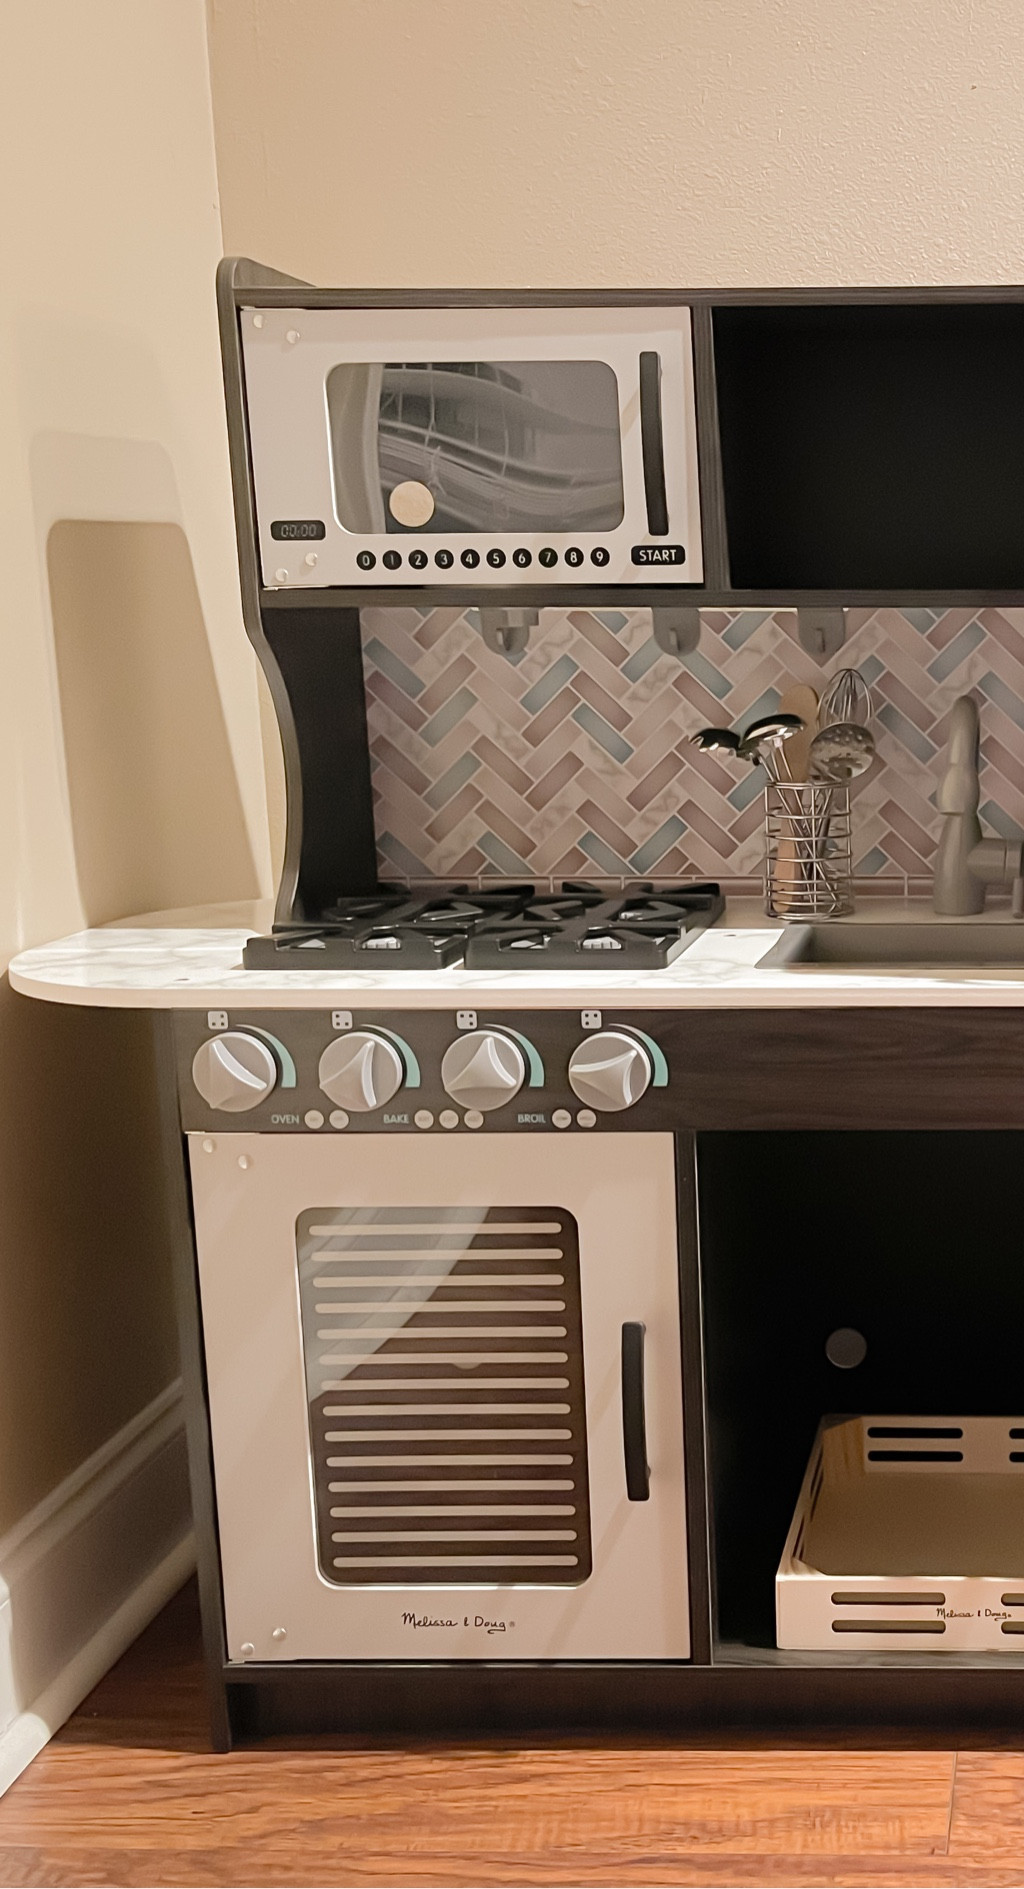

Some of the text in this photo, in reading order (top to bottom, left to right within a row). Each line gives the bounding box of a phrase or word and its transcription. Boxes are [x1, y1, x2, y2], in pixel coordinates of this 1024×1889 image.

[361, 554, 371, 567] 0
[414, 554, 422, 566] 2
[440, 553, 448, 565] 3
[465, 553, 473, 565] 4
[492, 552, 500, 564] 5
[518, 552, 526, 564] 6
[544, 551, 552, 563] 7
[570, 551, 578, 563] 8
[595, 551, 604, 563] 9
[639, 549, 677, 562] START
[271, 1114, 300, 1125] OVEN
[383, 1113, 409, 1125] BAKE
[517, 1113, 546, 1124] BROIL
[401, 1612, 459, 1629] Melissa
[474, 1615, 506, 1634] Doug
